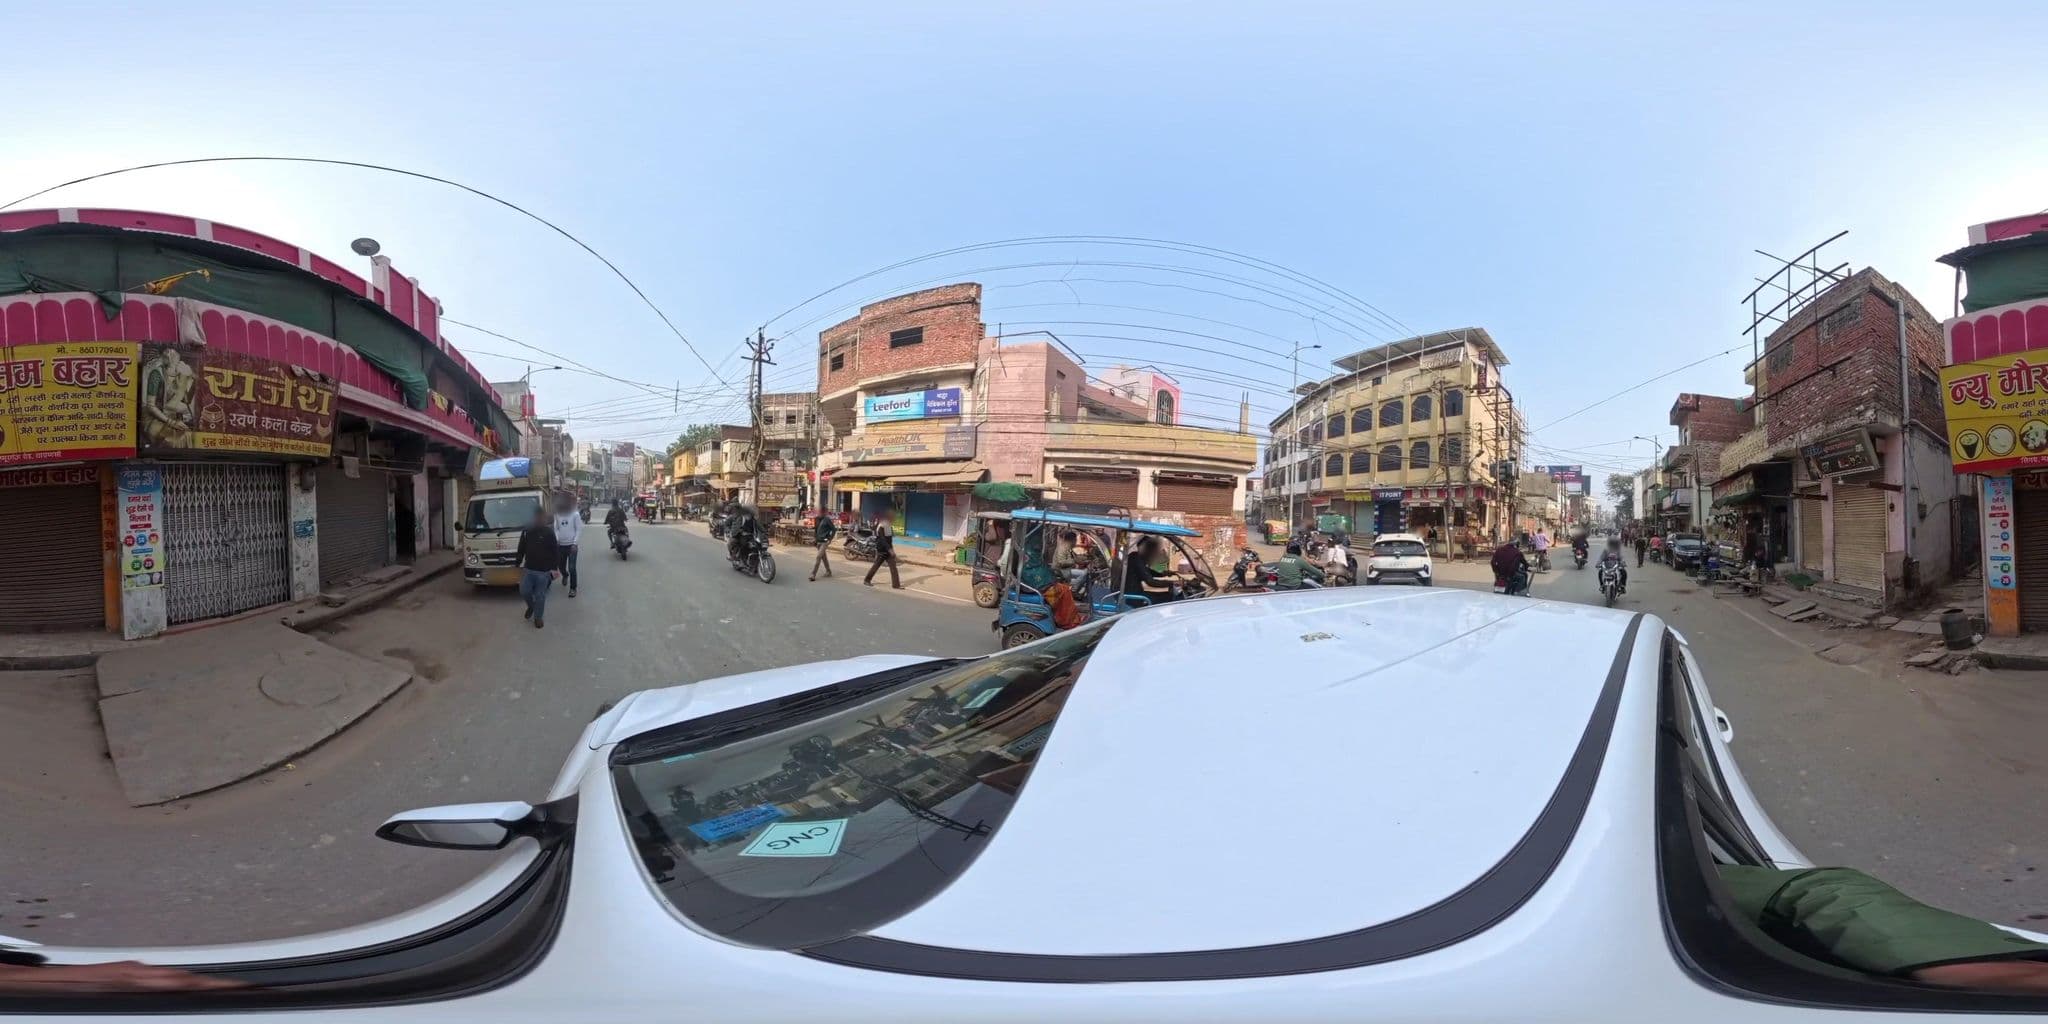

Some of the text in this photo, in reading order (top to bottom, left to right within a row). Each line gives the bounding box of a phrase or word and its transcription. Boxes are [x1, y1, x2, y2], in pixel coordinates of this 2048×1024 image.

[79, 346, 128, 355] 8601709401
[52, 356, 132, 389] बहार
[24, 394, 47, 403] लस्सी
[203, 366, 333, 416] राजेश
[1948, 373, 1997, 410] न्यू
[873, 399, 911, 412] Leeford
[228, 409, 258, 430] स्वर्ण
[261, 418, 288, 433] कला
[767, 826, 829, 850] CNG
